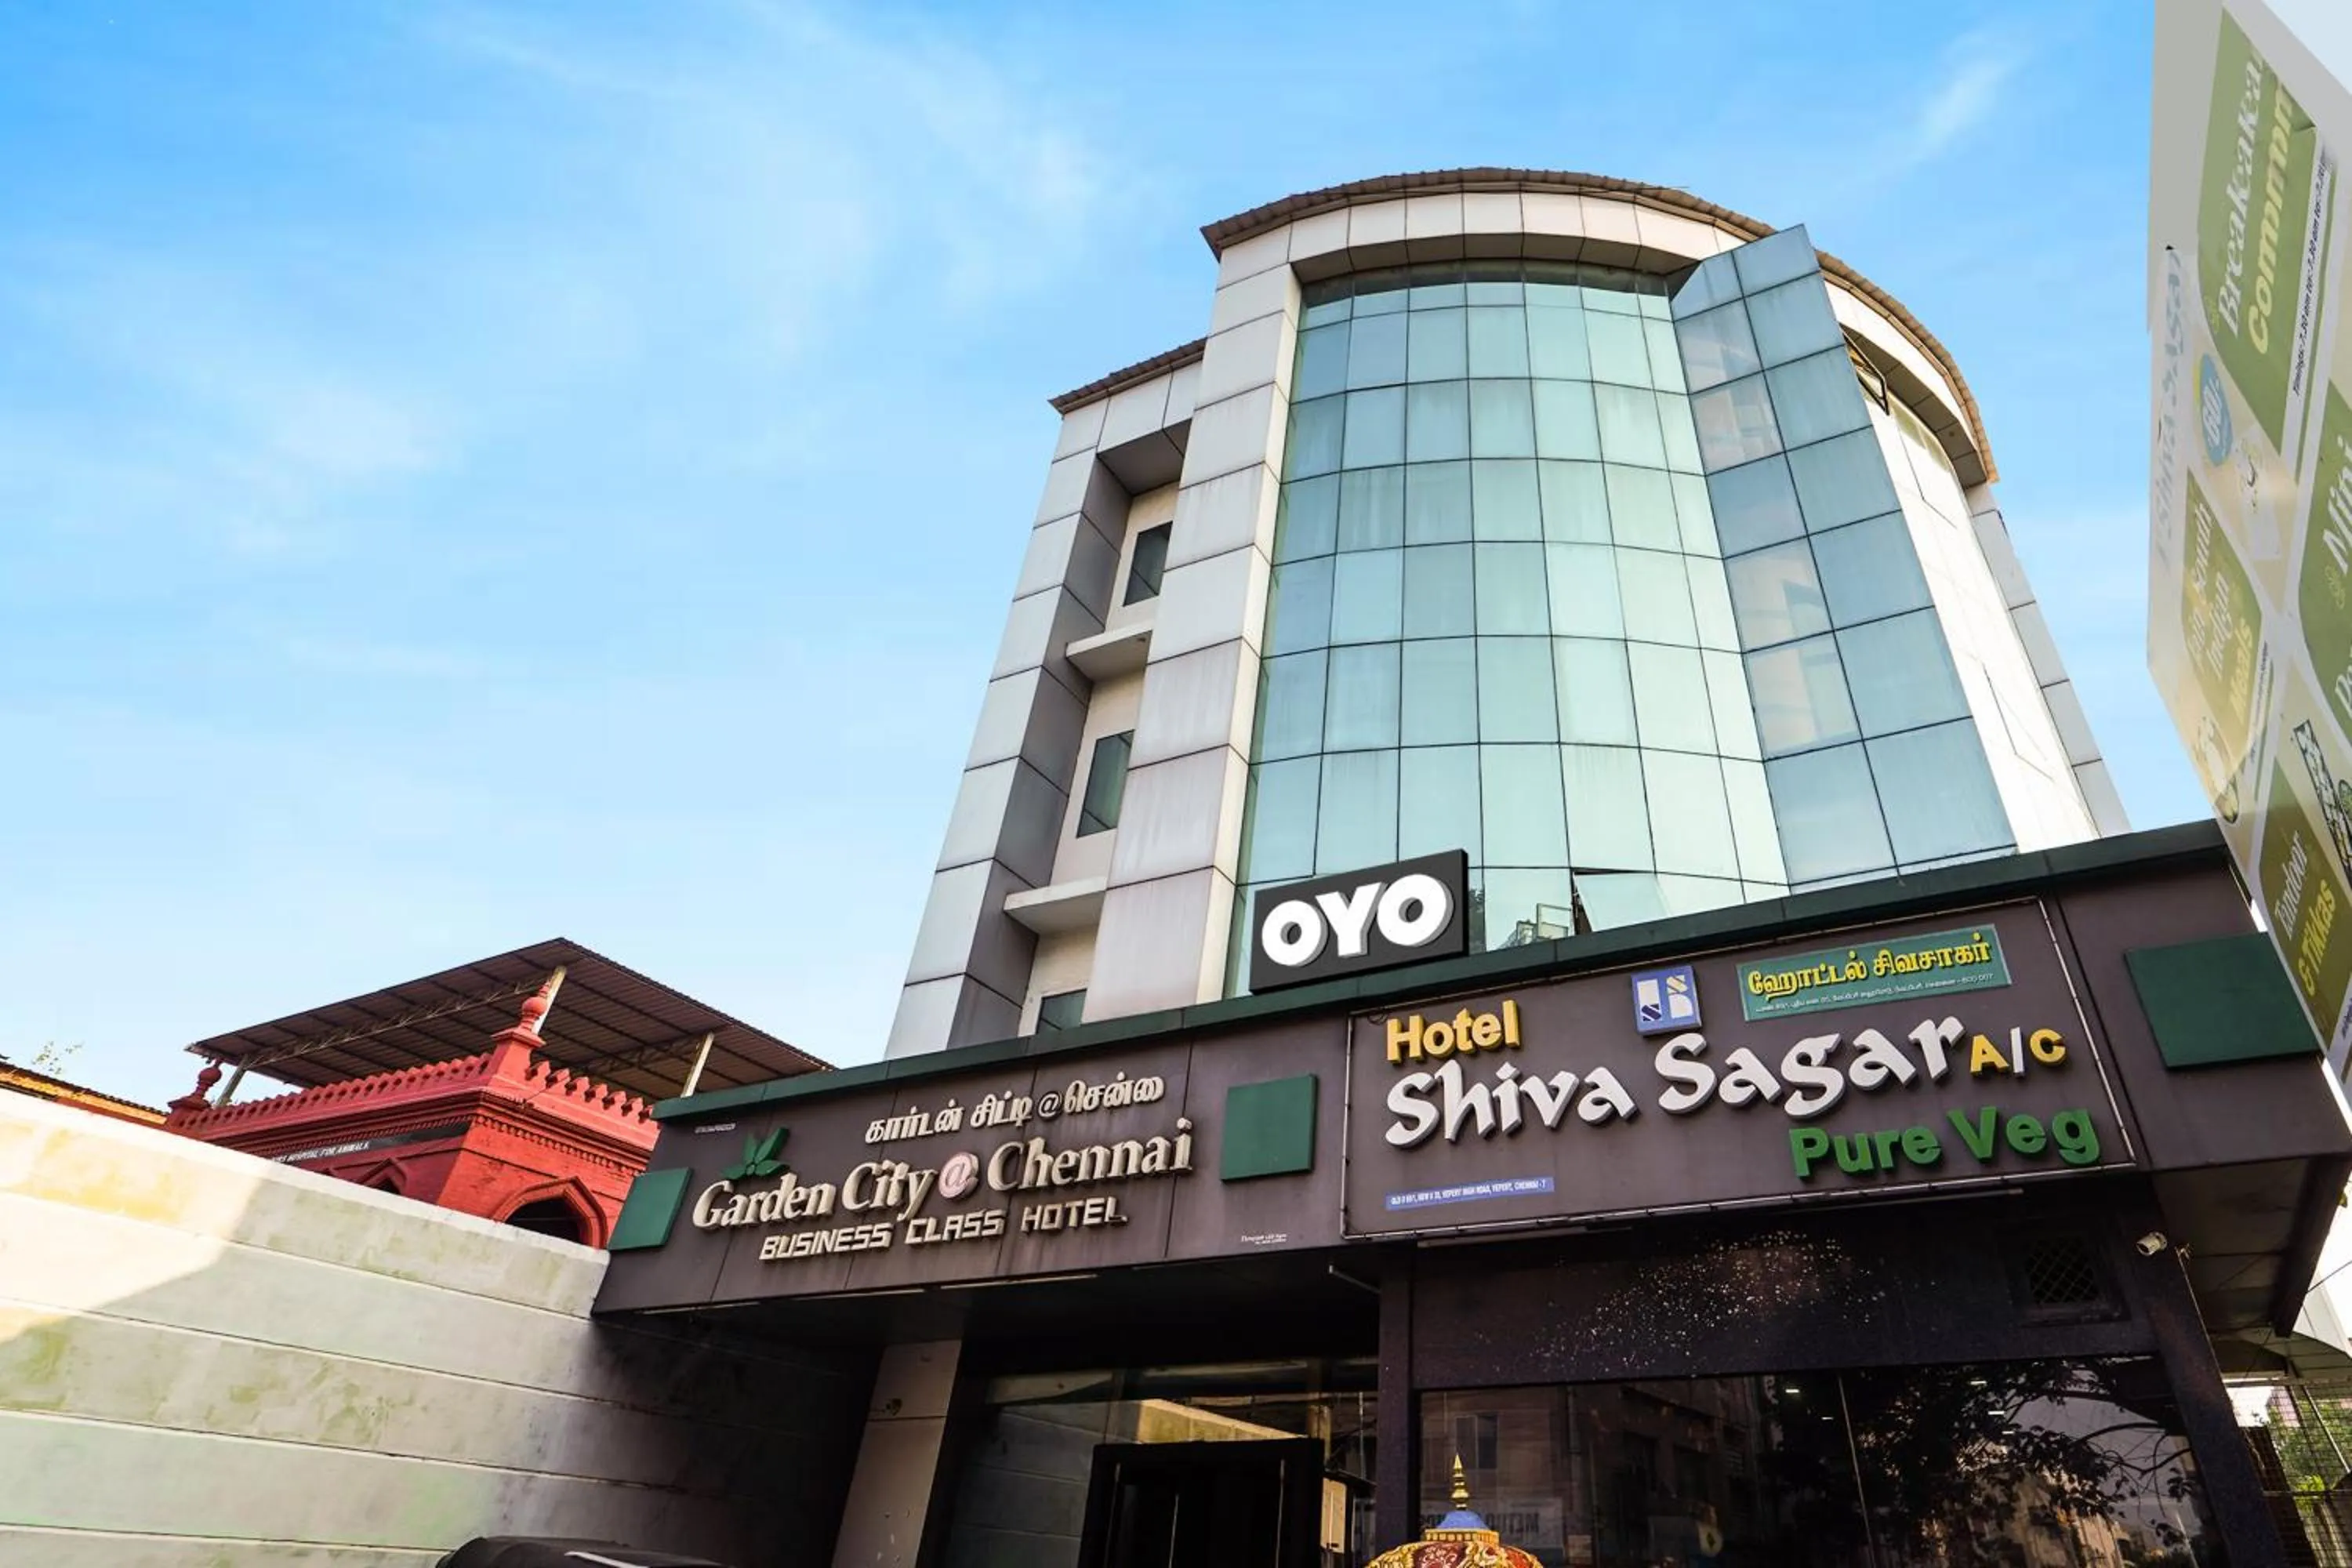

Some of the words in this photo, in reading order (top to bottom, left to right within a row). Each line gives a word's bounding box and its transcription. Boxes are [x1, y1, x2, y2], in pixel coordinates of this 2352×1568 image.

[2229, 619, 2253, 726] Meals
[1261, 873, 1454, 967] OYO
[2274, 829, 2307, 941] Tandoor
[2301, 878, 2336, 975] Tikkas
[1748, 949, 1869, 1002] ஹோட்டல்
[1873, 931, 1992, 977] சிவசாகர்
[1387, 1000, 1522, 1065] Hotel
[864, 1098, 964, 1144] கார்டன்
[970, 1090, 1033, 1128] சிட்டி
[1385, 1058, 1639, 1149] Shiva
[1653, 1015, 1966, 1119] Sagar
[1969, 1026, 2067, 1079] A/C
[693, 1172, 837, 1228] Garden
[987, 1117, 1192, 1191] Chennai
[1788, 1125, 1944, 1178] Pure
[1947, 1105, 2102, 1167] Veg
[759, 1221, 893, 1260] BUSINESS
[905, 1208, 1007, 1245] CLASS
[1021, 1196, 1128, 1232] HOTEL
